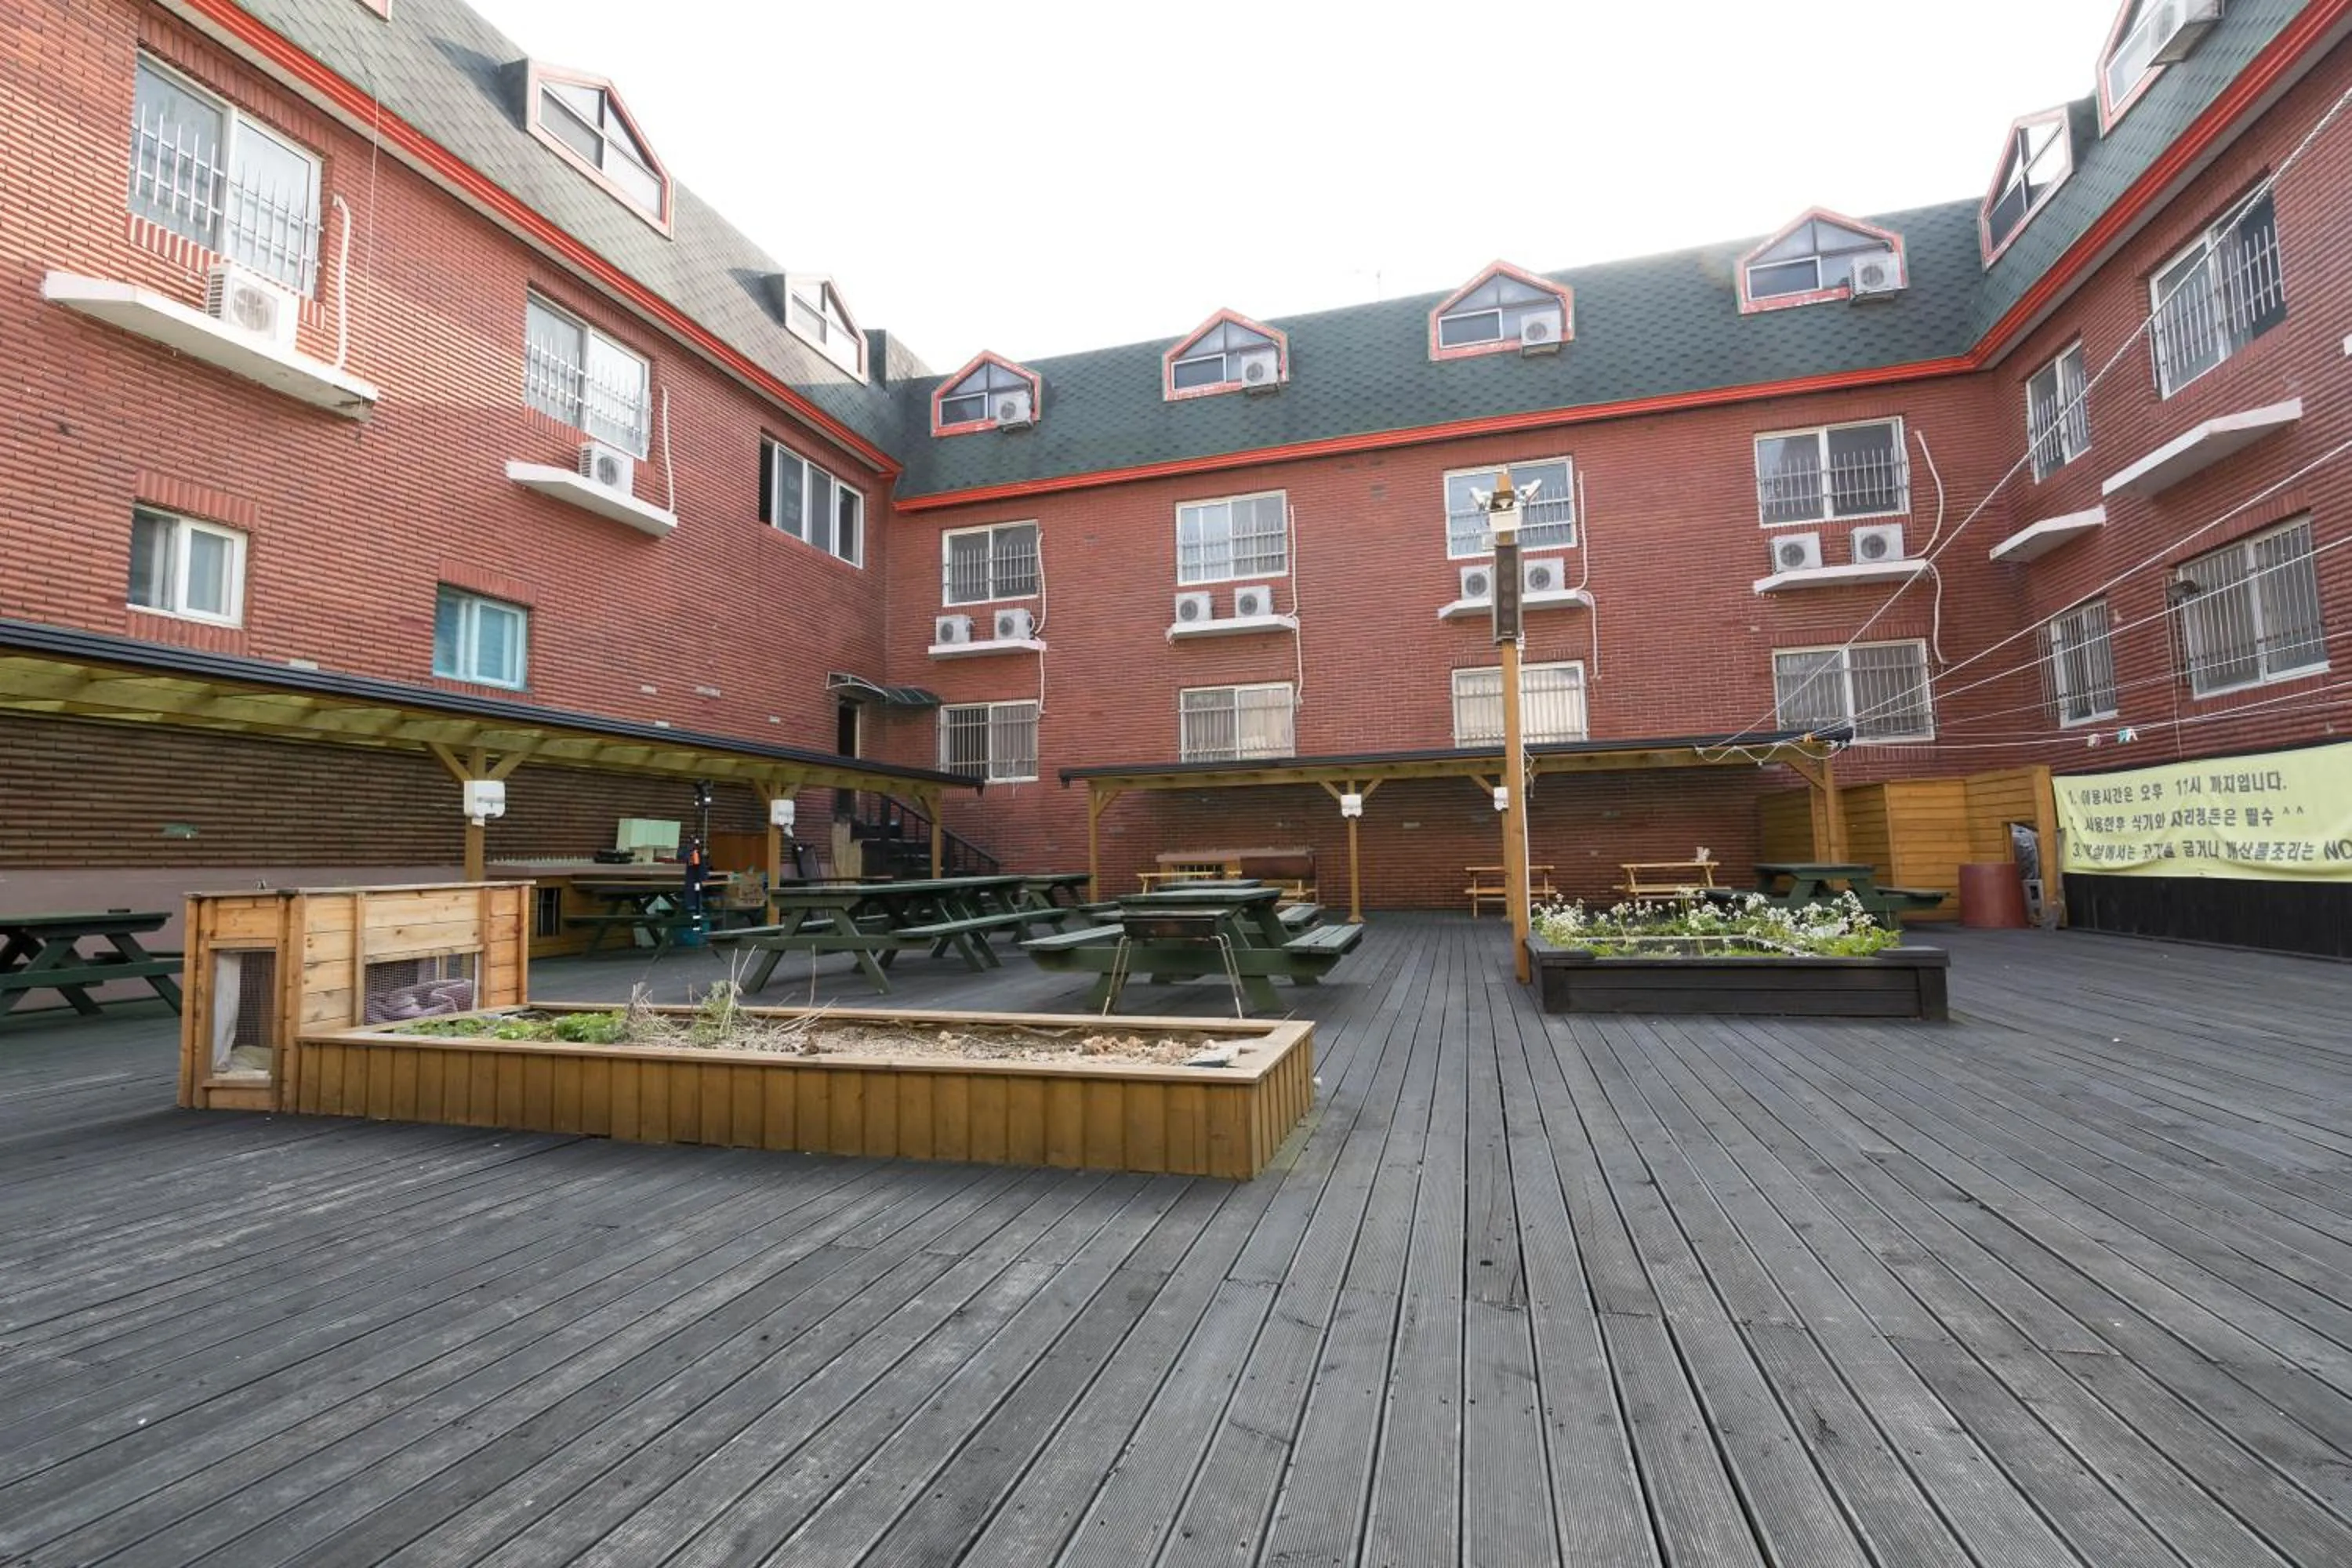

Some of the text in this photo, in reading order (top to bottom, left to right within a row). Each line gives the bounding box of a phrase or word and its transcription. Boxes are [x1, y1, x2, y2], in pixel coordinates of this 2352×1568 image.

[2141, 783, 2163, 801] 오후
[2209, 771, 2287, 794] 까지입니다.
[2132, 812, 2165, 833] 식기와
[2171, 807, 2236, 828] 자리정돈은
[2245, 806, 2274, 827] 필수
[2324, 838, 2352, 861] NO
